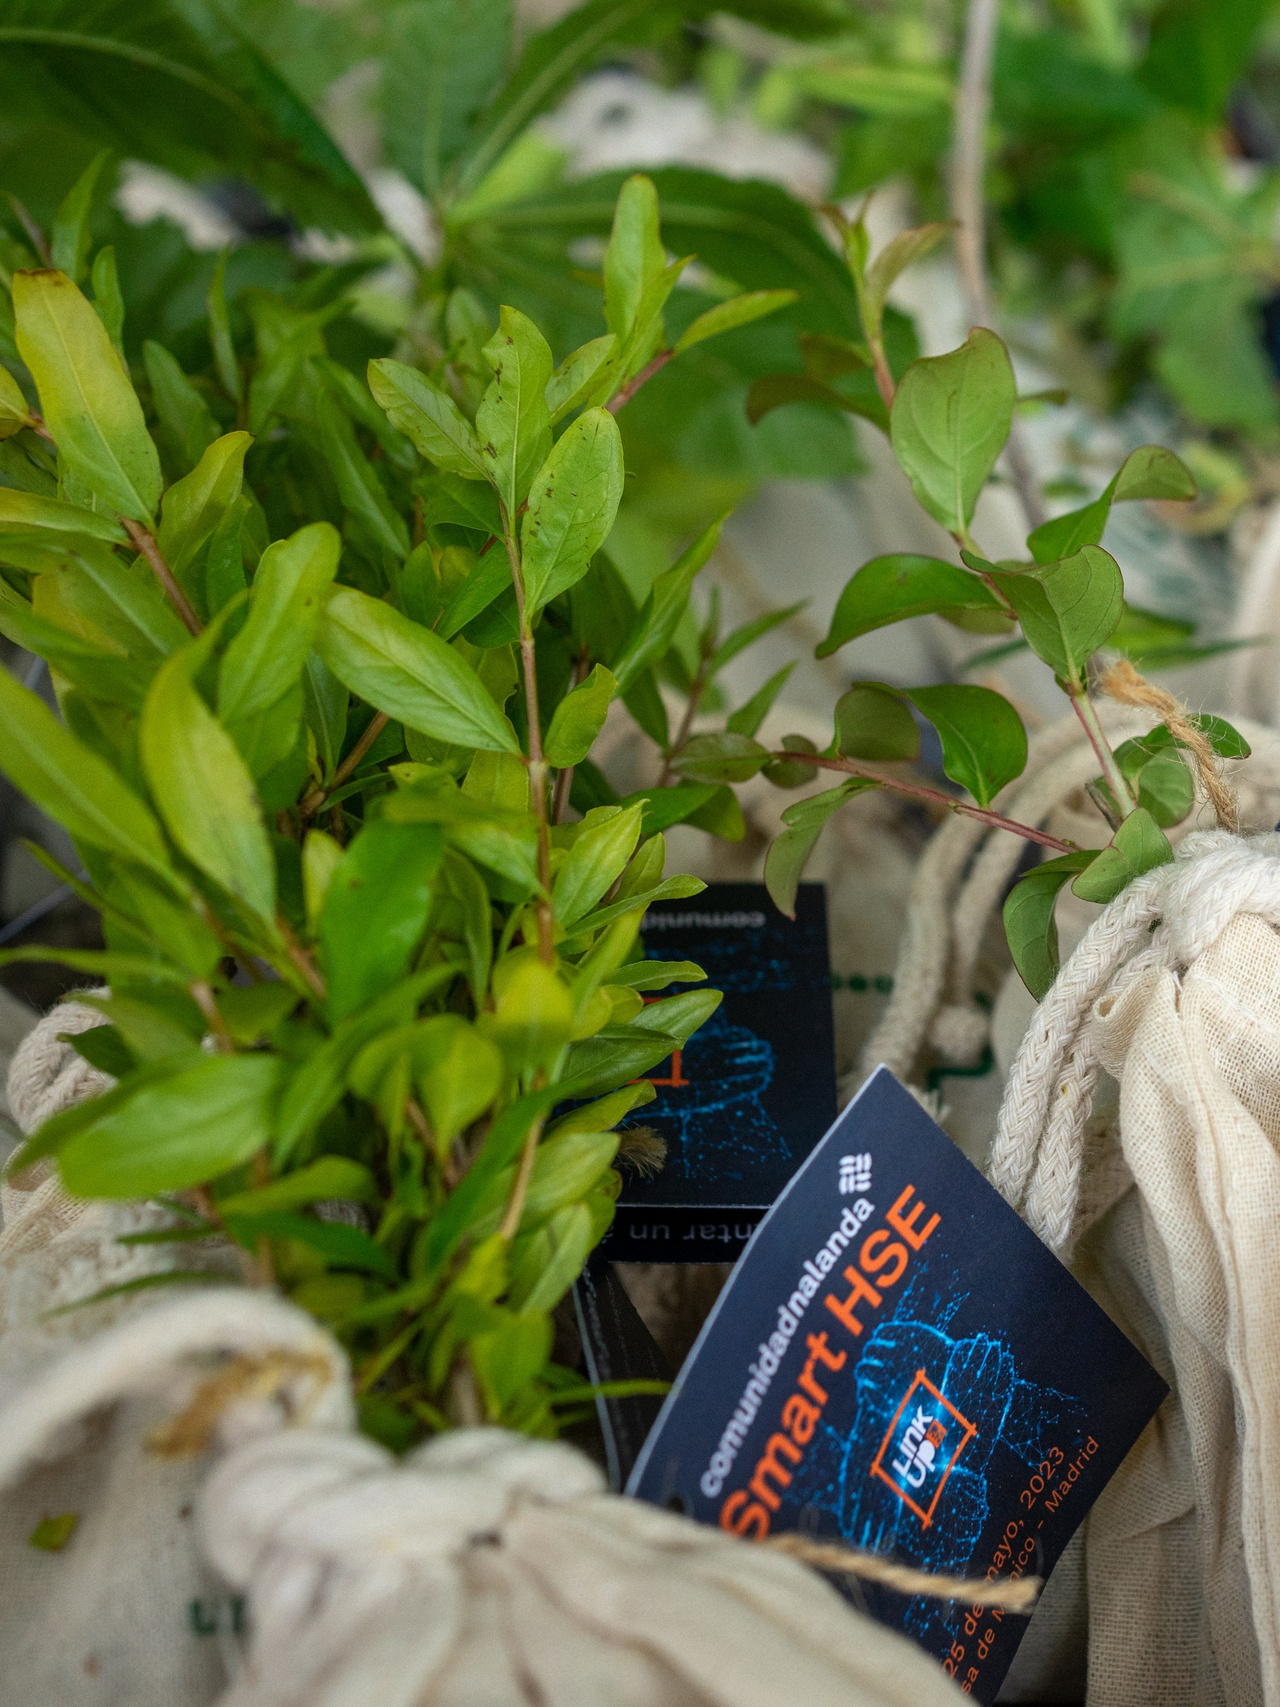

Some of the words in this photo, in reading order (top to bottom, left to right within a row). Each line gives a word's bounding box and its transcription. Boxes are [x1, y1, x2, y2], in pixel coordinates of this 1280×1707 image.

[682, 1223, 757, 1243] ntar
[701, 1196, 875, 1499] comunidadnalanda
[720, 1331, 848, 1541] Smart
[824, 1184, 942, 1337] HSE
[943, 1642, 965, 1678] 25
[965, 1602, 986, 1636] de
[1021, 1447, 1064, 1510] 2023
[978, 1628, 996, 1660] de
[1045, 1437, 1099, 1511] Madrid
